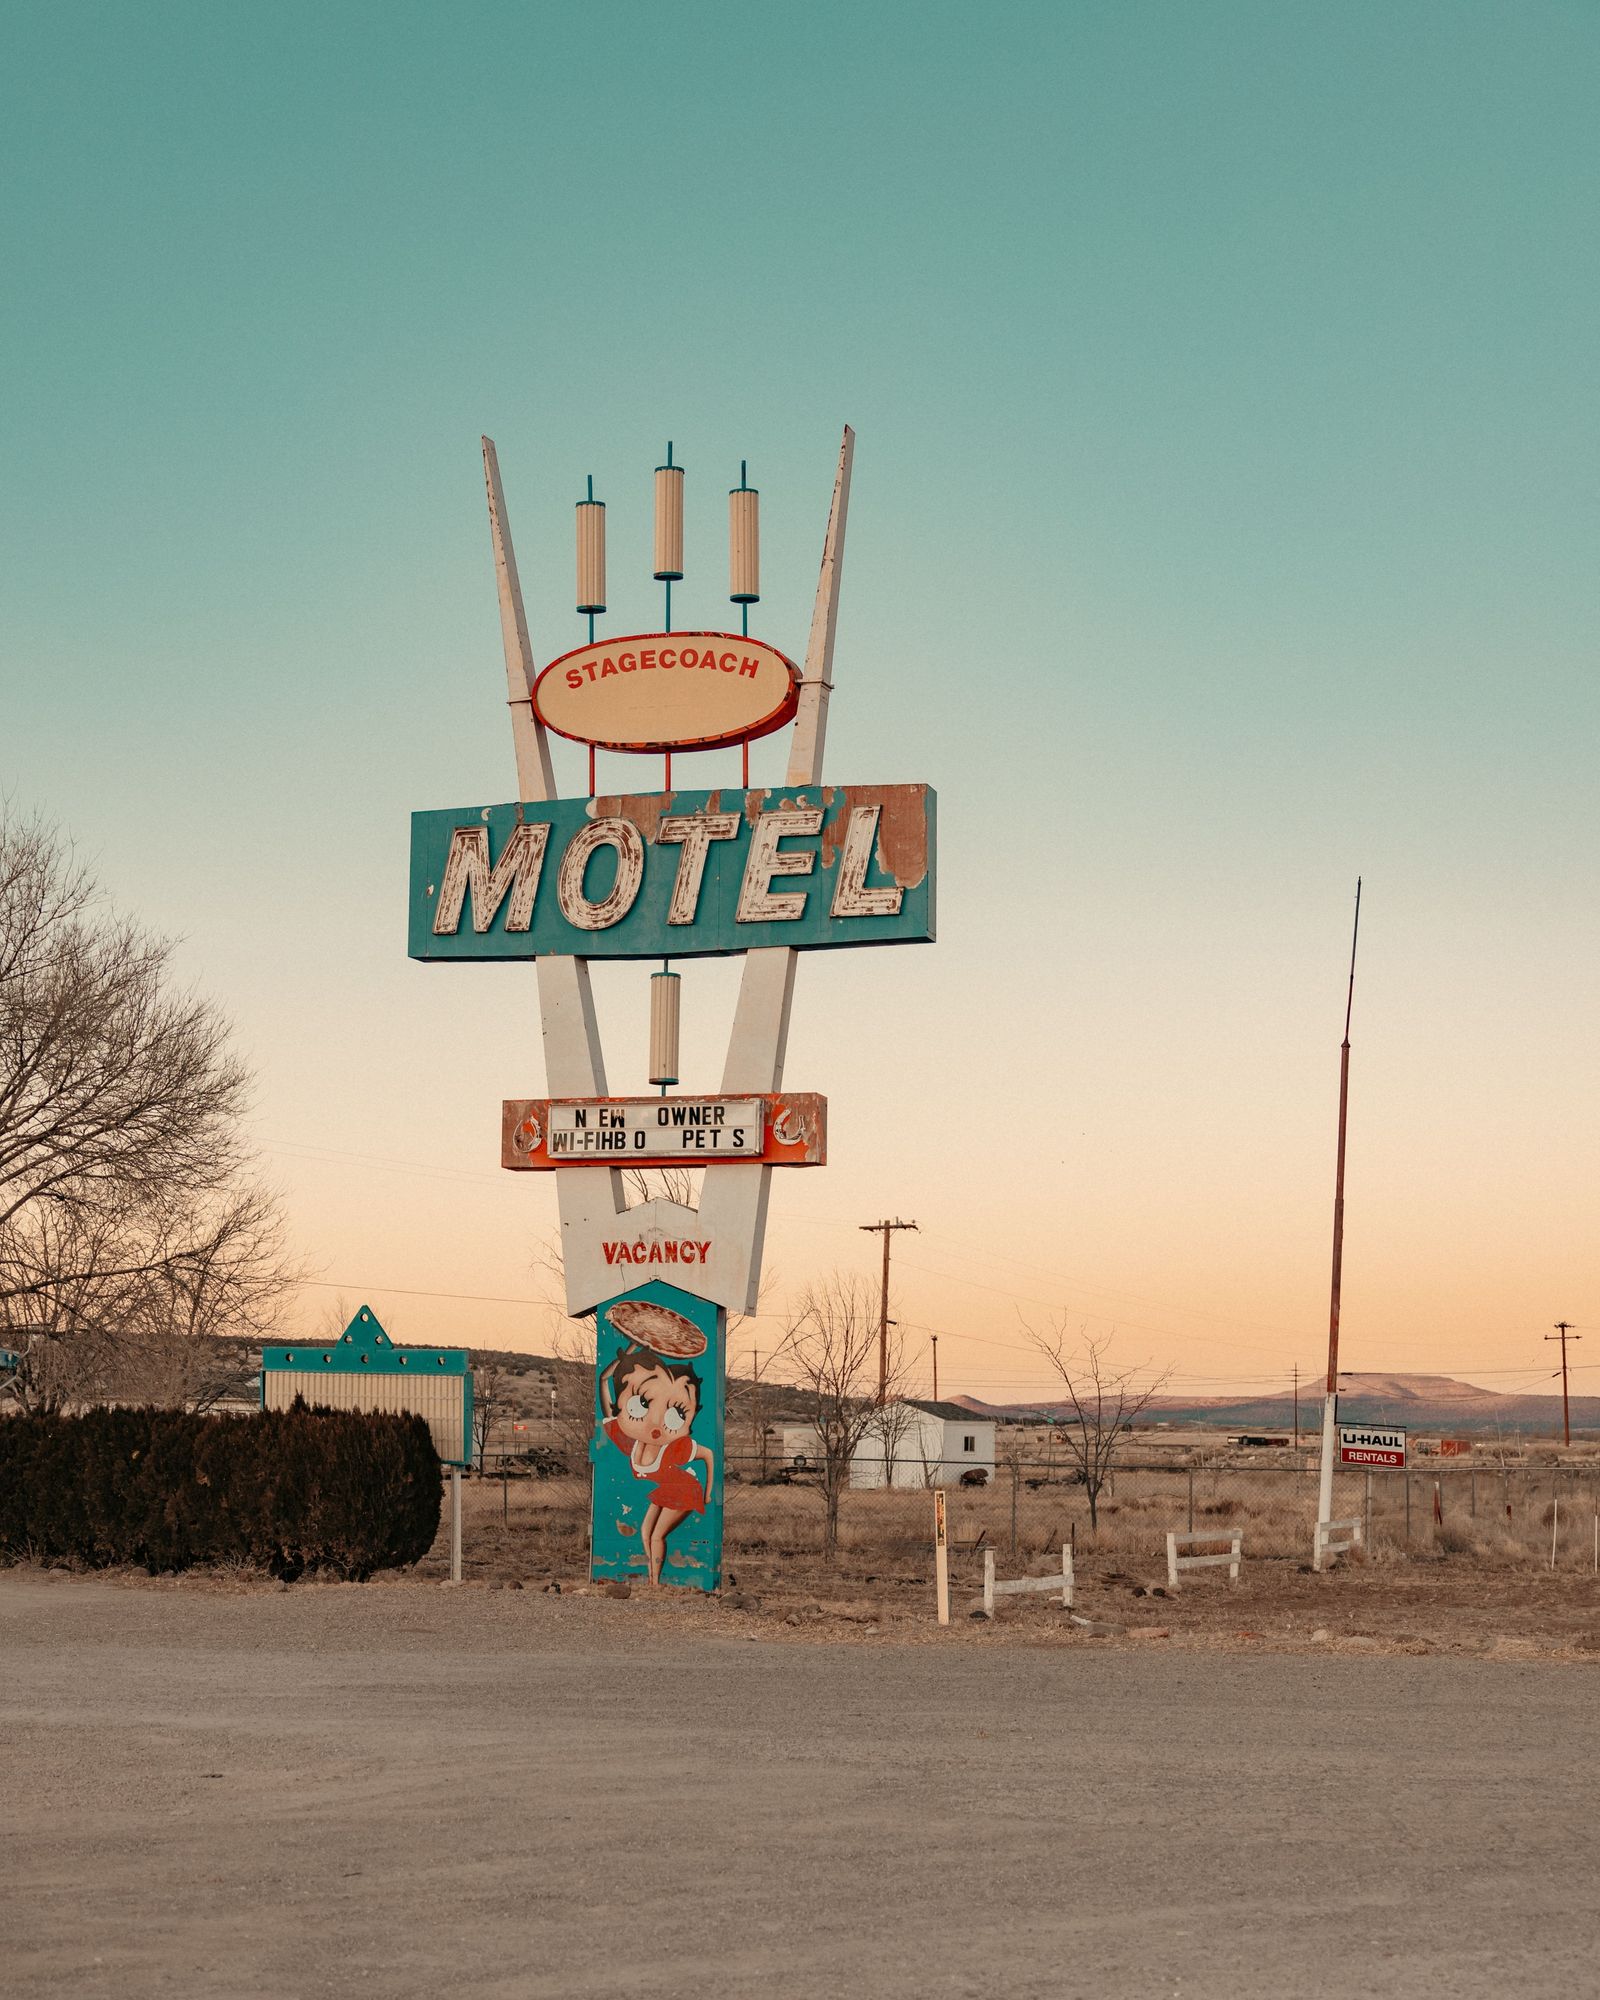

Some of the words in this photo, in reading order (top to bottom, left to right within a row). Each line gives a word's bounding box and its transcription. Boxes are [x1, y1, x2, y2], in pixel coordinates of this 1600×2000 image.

[564, 647, 760, 690] STAGECOACH
[431, 802, 905, 936] MOTEL
[575, 1108, 625, 1129] NEW
[657, 1105, 725, 1127] OWNER
[682, 1128, 745, 1149] PETS
[601, 1240, 712, 1265] VACANCY
[1343, 1433, 1402, 1447] U-HAUL
[1348, 1451, 1397, 1463] RENTALS
